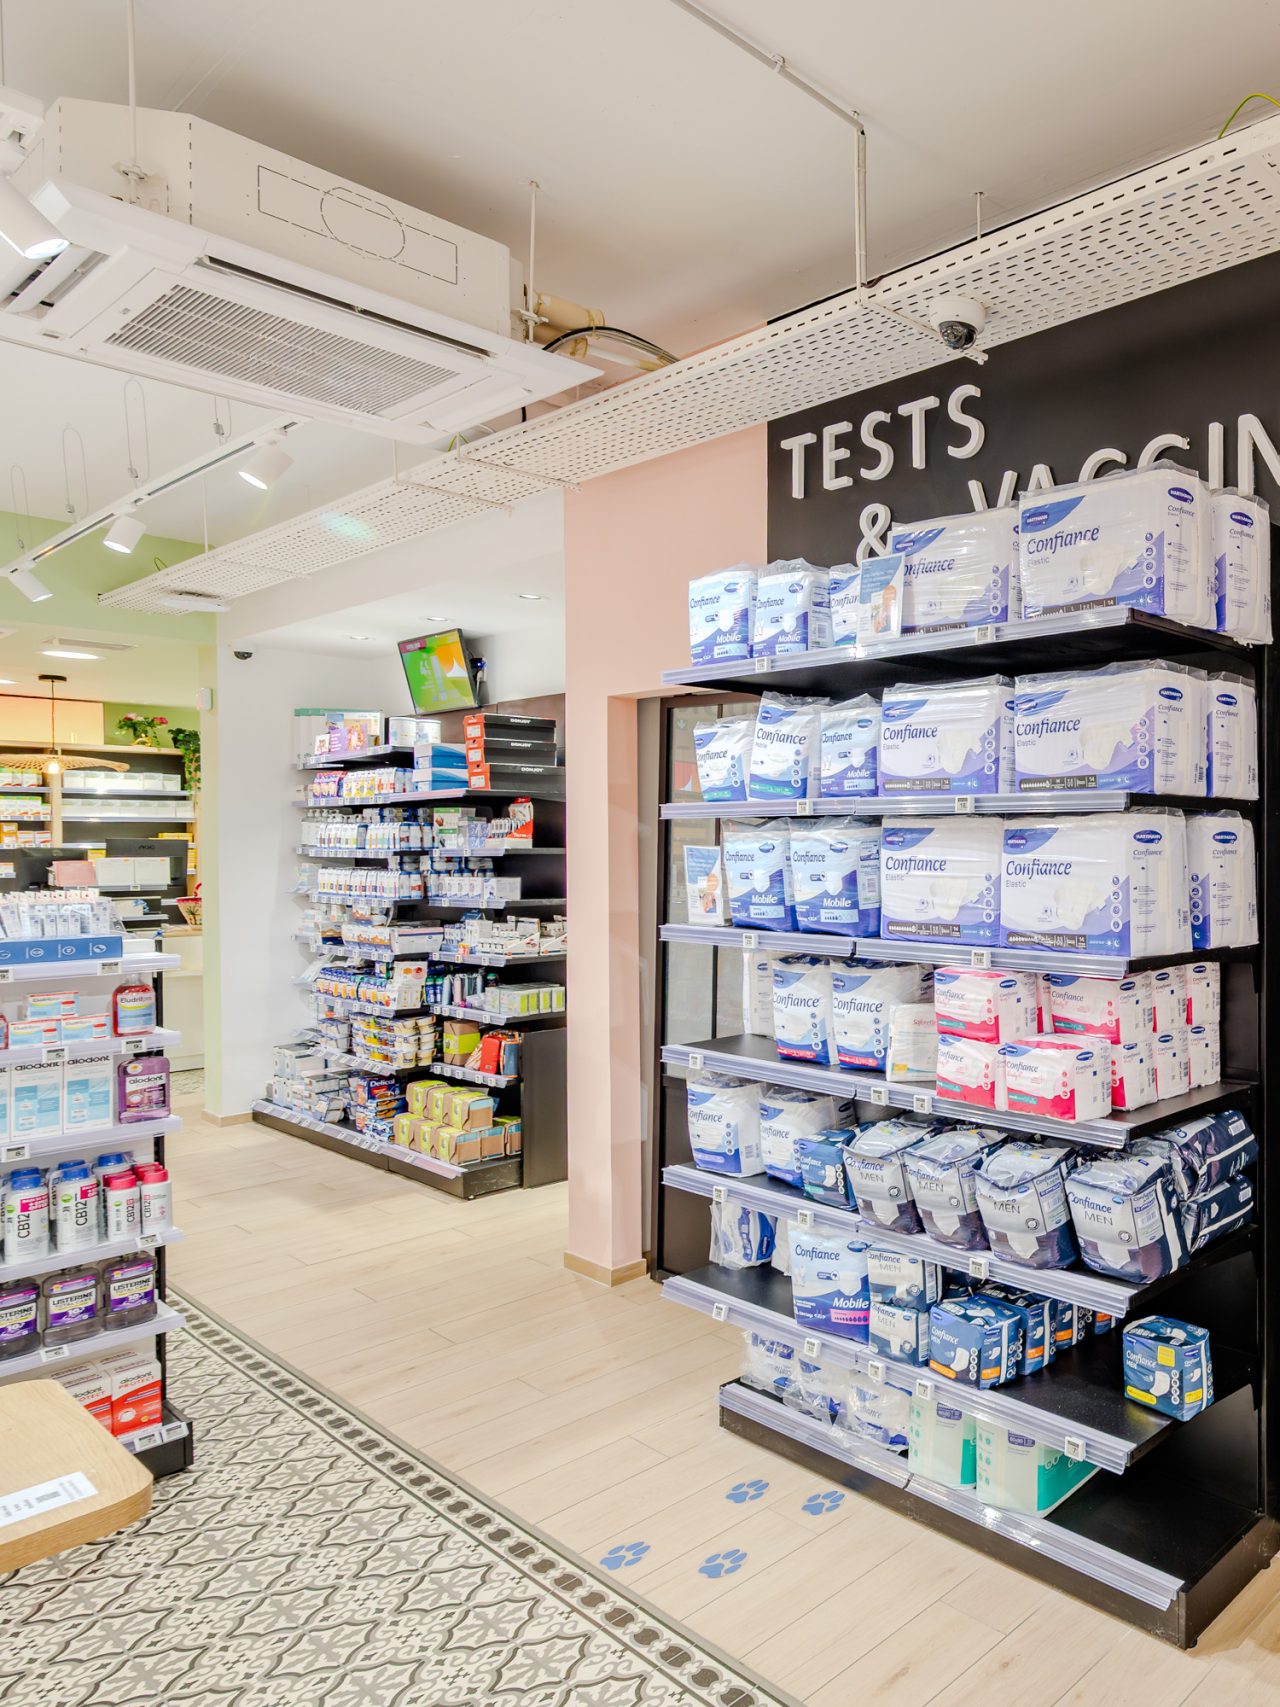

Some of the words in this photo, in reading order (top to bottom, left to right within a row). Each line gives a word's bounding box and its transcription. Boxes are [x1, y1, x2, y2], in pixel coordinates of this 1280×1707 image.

[780, 384, 985, 500] TESTS
[1027, 526, 1101, 556] Confiance
[716, 633, 741, 643] Mobile
[883, 724, 938, 744] Confiance
[1016, 716, 1081, 740] Confiance
[756, 727, 806, 746] Confiance
[821, 731, 853, 745] Confiance
[846, 769, 871, 779] Mobile
[1135, 832, 1162, 841] HARTMANN
[725, 850, 755, 865] Confiance
[792, 850, 826, 865] Confiance
[885, 855, 947, 875] Confiance
[1005, 858, 1073, 880] Confiance
[751, 894, 778, 904] Mobile
[822, 896, 852, 908] Mobile
[935, 987, 966, 1001] Confiance
[1051, 990, 1085, 1002] Confiance
[67, 1055, 110, 1066] alodont
[1006, 1060, 1040, 1074] Confiance
[128, 1074, 164, 1085] alodont
[760, 1122, 790, 1139] onfiance
[859, 1171, 885, 1184] MEN
[917, 1179, 944, 1193] MEN
[993, 1201, 1021, 1215] MEN
[1067, 1190, 1112, 1214] Confiance
[75, 1199, 88, 1226] CB12
[1084, 1209, 1114, 1227] MEN
[18, 1213, 31, 1239] CB12
[794, 1243, 841, 1261] Confiance
[113, 1277, 151, 1291] LISTERINE
[52, 1291, 93, 1306] LISTERINE
[832, 1296, 870, 1310] Mobile
[931, 1326, 960, 1345] Confiance
[1126, 1350, 1157, 1369] Confiance
[118, 1375, 155, 1390] PROTECT
